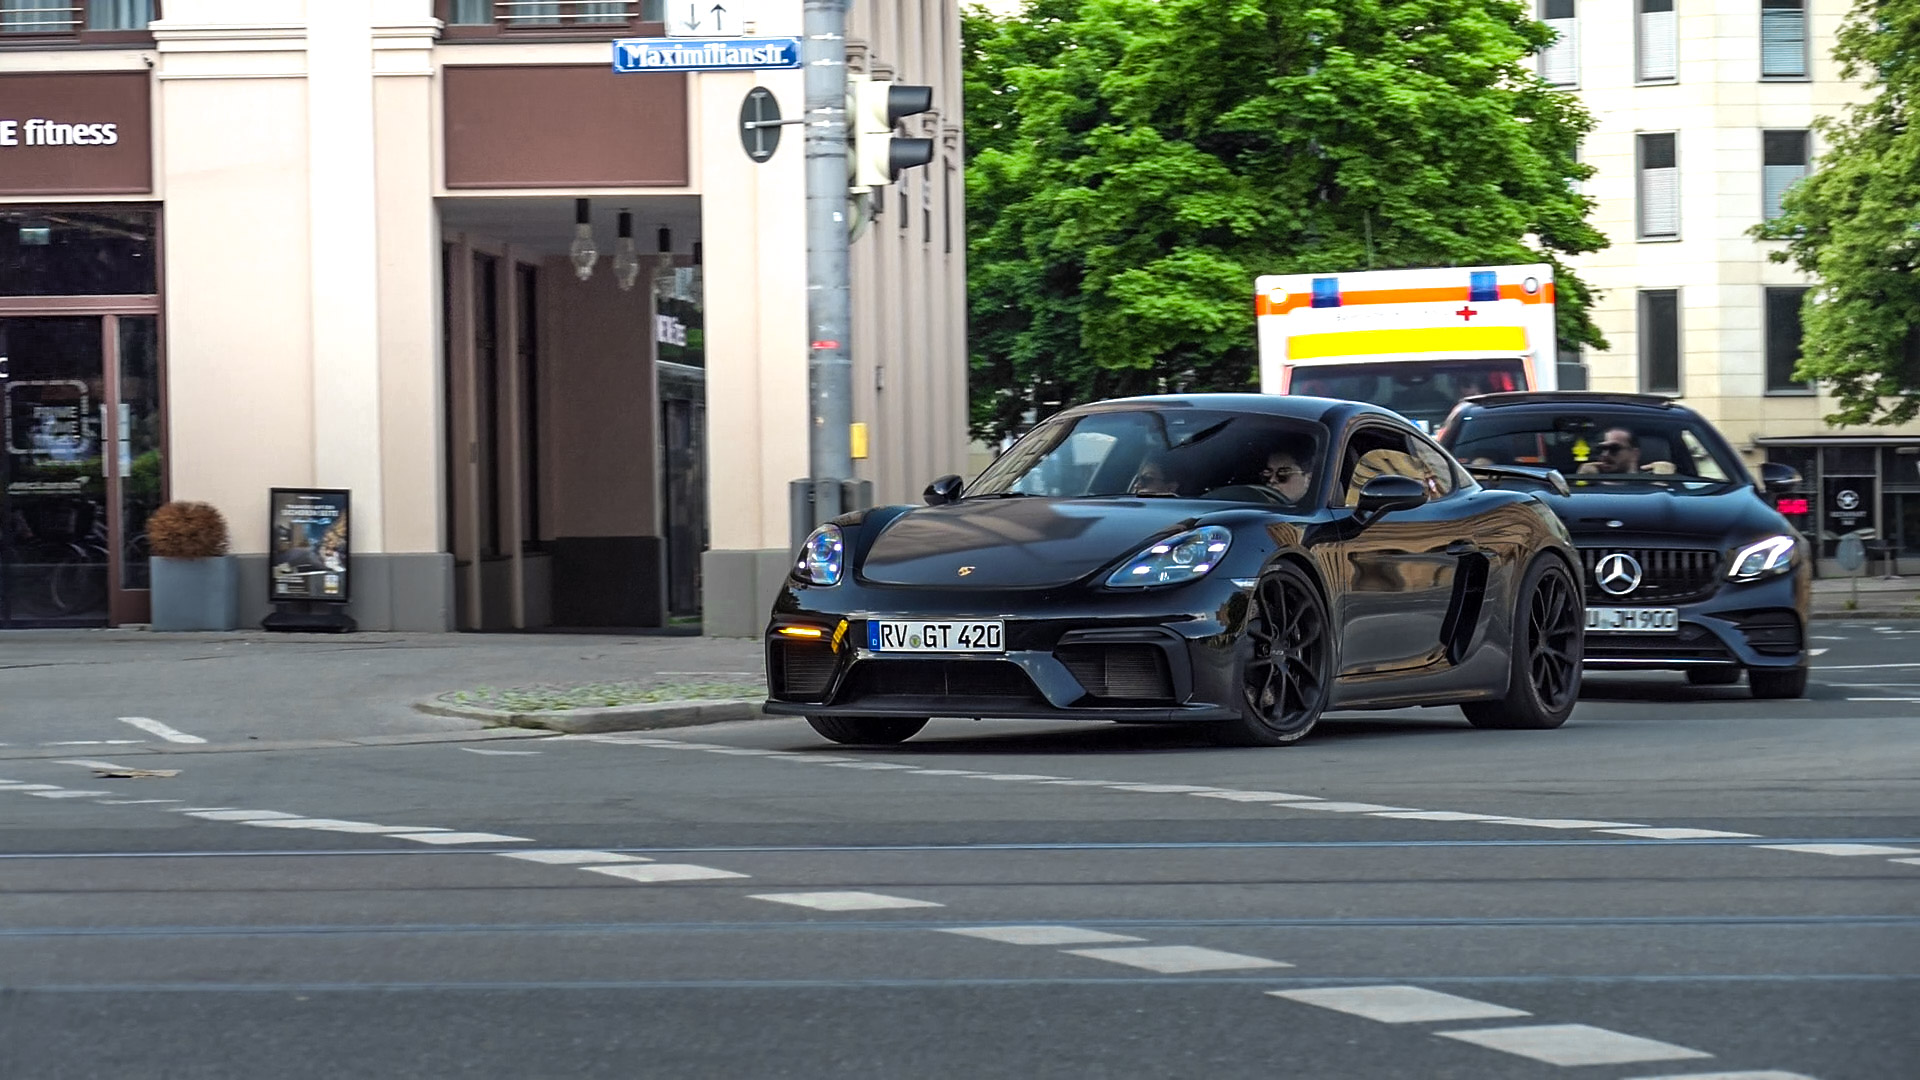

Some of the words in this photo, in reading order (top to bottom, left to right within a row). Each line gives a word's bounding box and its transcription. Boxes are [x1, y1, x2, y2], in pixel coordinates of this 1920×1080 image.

[626, 43, 788, 67] Maximilianstr.
[23, 119, 118, 146] fitness
[1610, 610, 1637, 628] JH
[1639, 610, 1676, 628] 900
[872, 638, 878, 646] D
[881, 624, 908, 648] RV
[923, 625, 951, 648] GT
[958, 625, 1001, 648] 420
